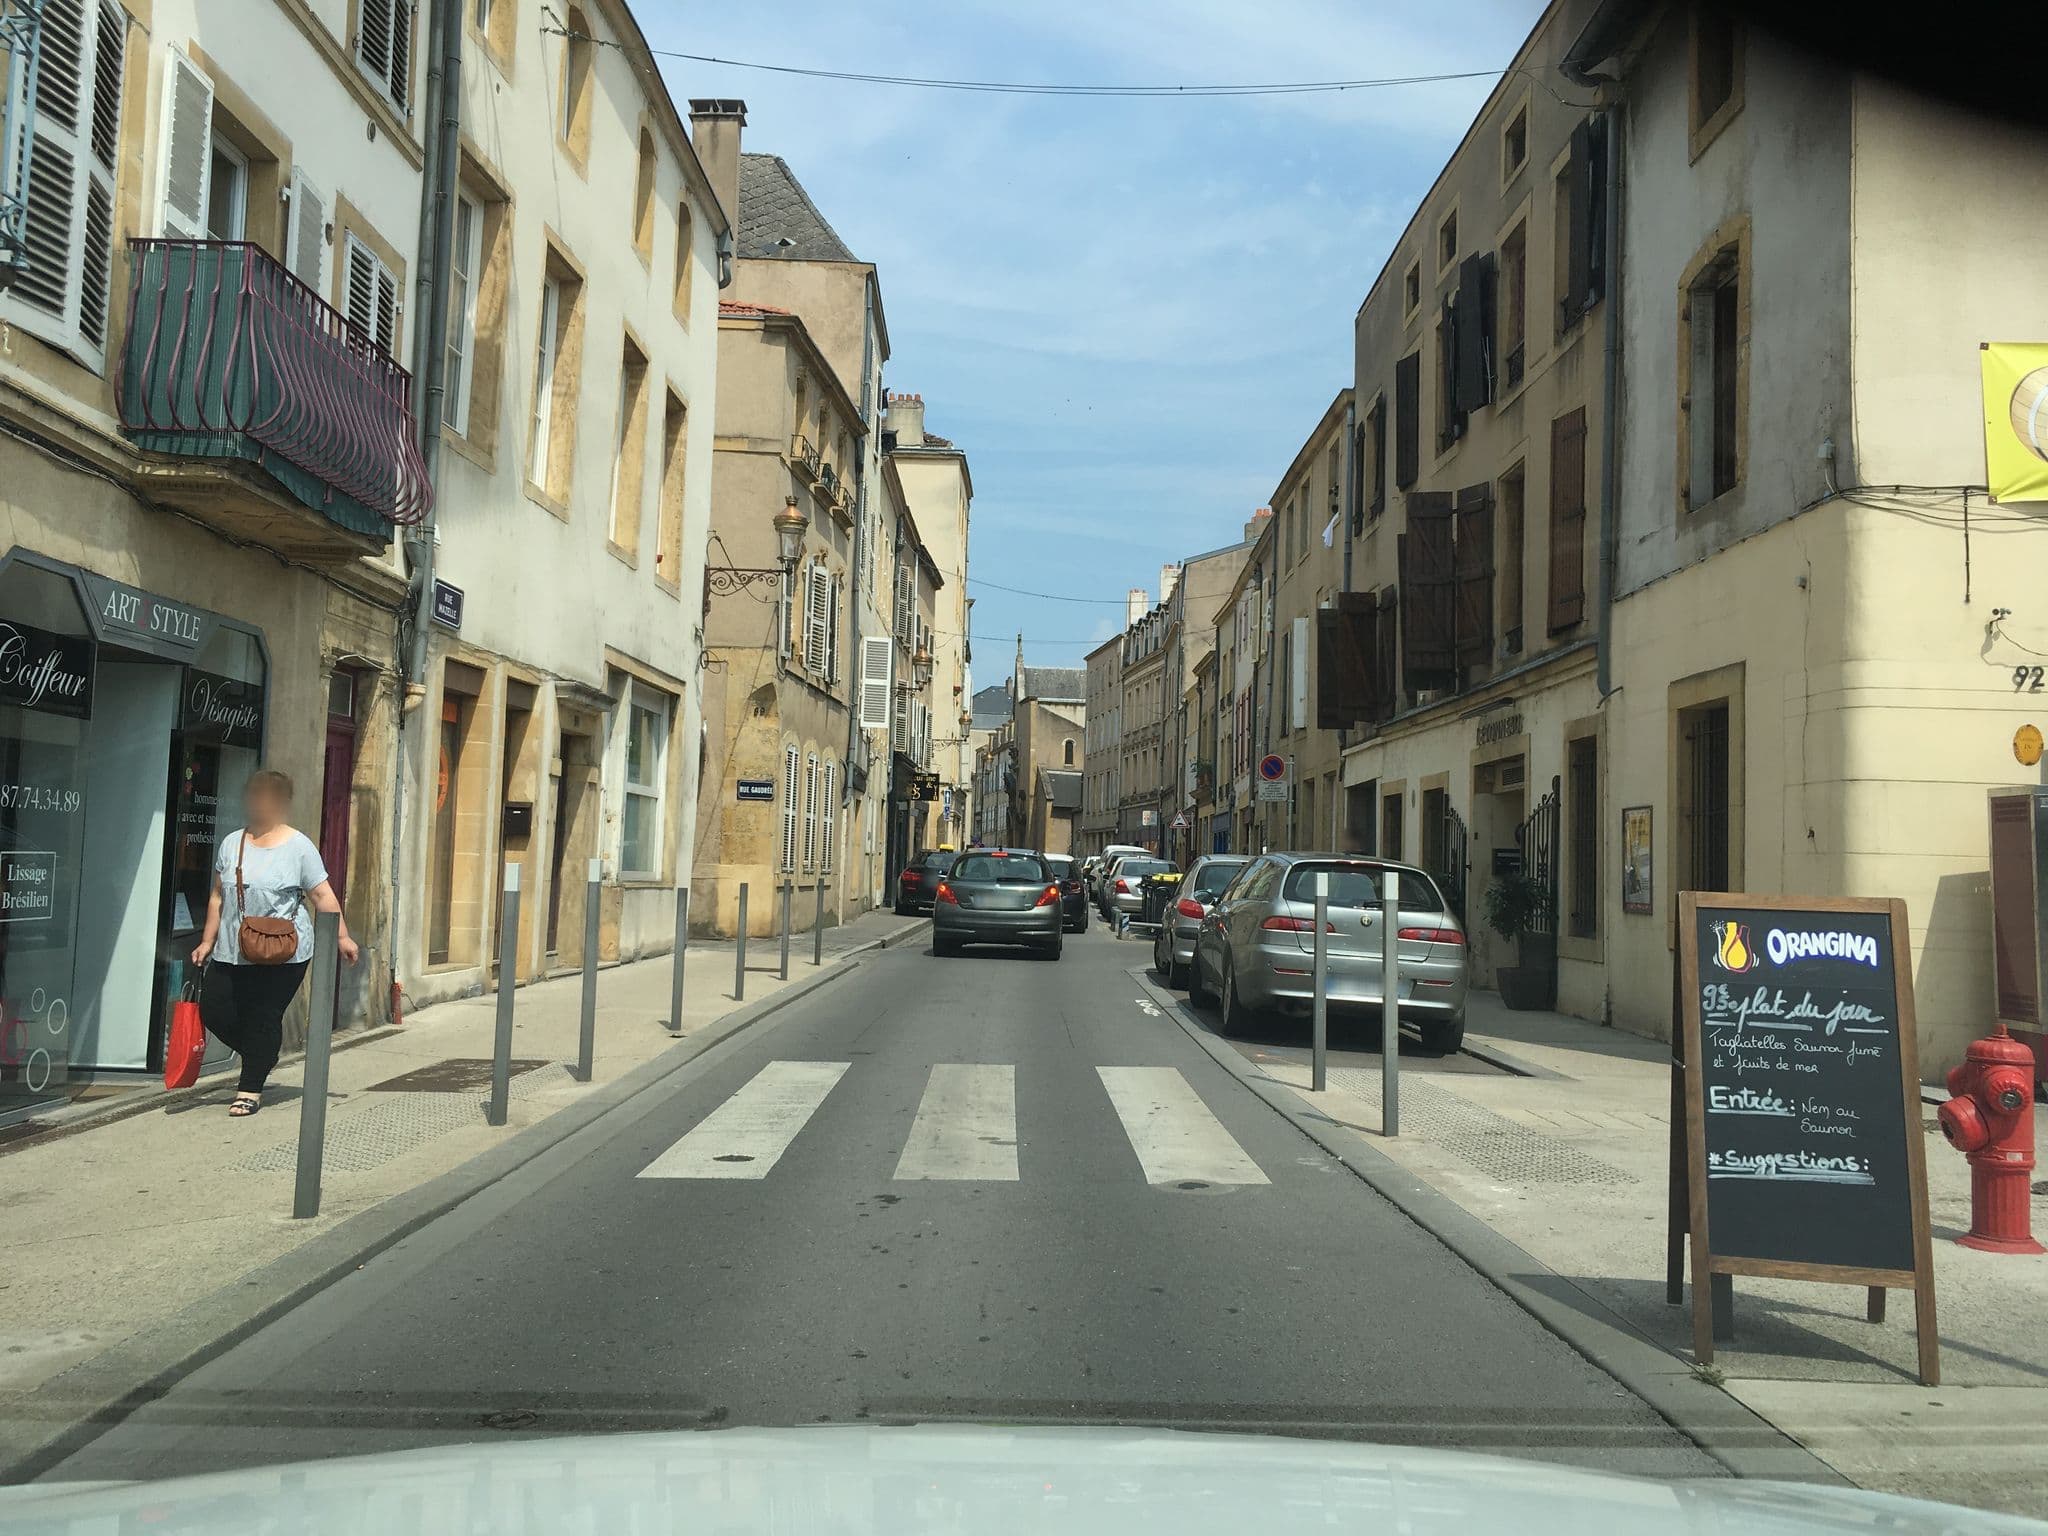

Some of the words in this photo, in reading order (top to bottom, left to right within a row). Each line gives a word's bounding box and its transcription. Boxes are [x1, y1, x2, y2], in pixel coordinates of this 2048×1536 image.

[104, 590, 140, 623] ART
[150, 604, 200, 642] STYLE
[0, 622, 86, 706] Coiffeur
[2014, 665, 2045, 689] 92
[191, 678, 259, 742] Visagiste
[8, 864, 48, 885] Lissage
[2, 891, 49, 909] Brésilien
[1767, 928, 1877, 966] ORANGINA
[1734, 986, 1787, 1032] plat
[1784, 991, 1825, 1019] du
[1825, 990, 1885, 1036] jour
[1709, 1028, 1787, 1056] Tagliatelles
[1794, 1038, 1843, 1052] Saumon
[1713, 1055, 1724, 1068] et
[1732, 1055, 1770, 1075] fruits
[1776, 1057, 1789, 1071] de
[1836, 1108, 1859, 1119] au
[1800, 1118, 1856, 1137] Saumon
